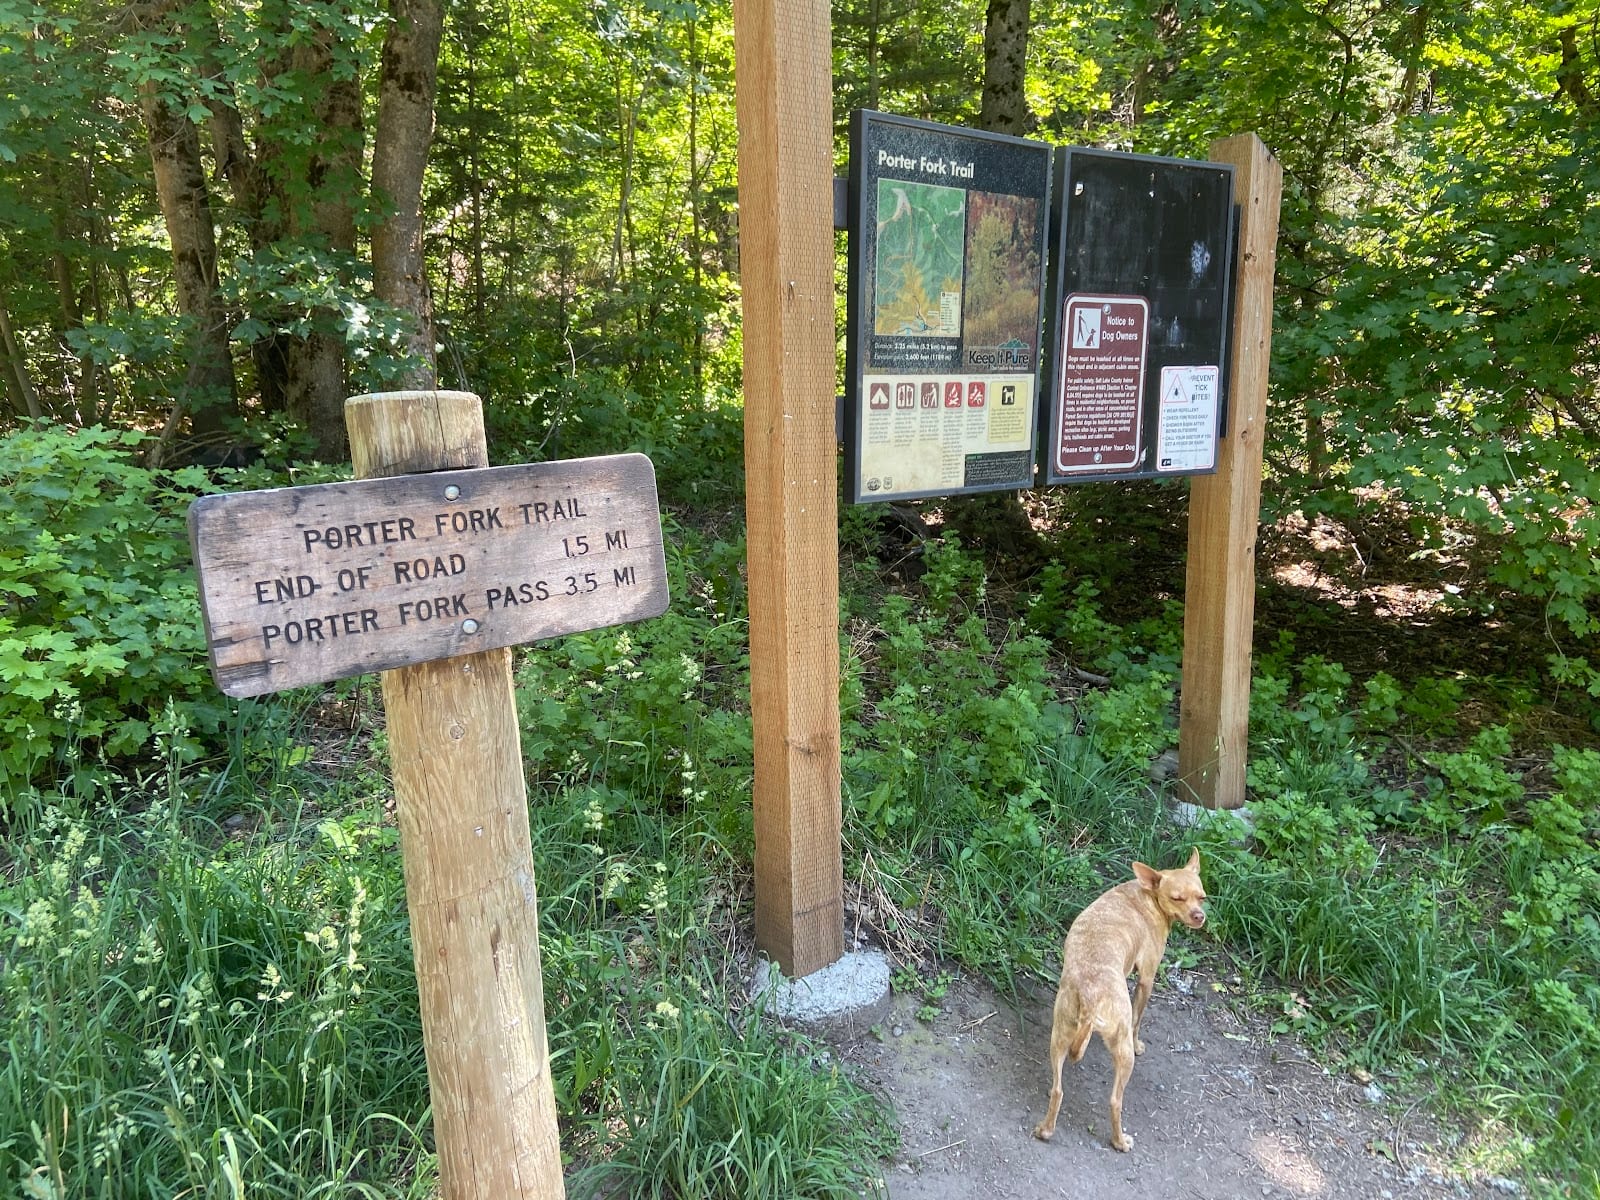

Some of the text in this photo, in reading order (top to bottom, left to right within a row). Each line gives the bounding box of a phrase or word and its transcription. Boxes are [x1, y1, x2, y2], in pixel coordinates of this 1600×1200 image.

[878, 150, 974, 178] Porter Fork Trail
[1106, 316, 1135, 326] Notice to
[1102, 330, 1138, 342] Dog Owners
[968, 350, 996, 368] Keep
[998, 350, 1003, 364] It
[1006, 350, 1029, 364] Pure
[303, 498, 587, 554] PORTER FORK TRAIL
[254, 530, 628, 604] END OF ROAD 1.5 MI
[262, 566, 636, 650] PORTER FORK PASS 3.5 MI
